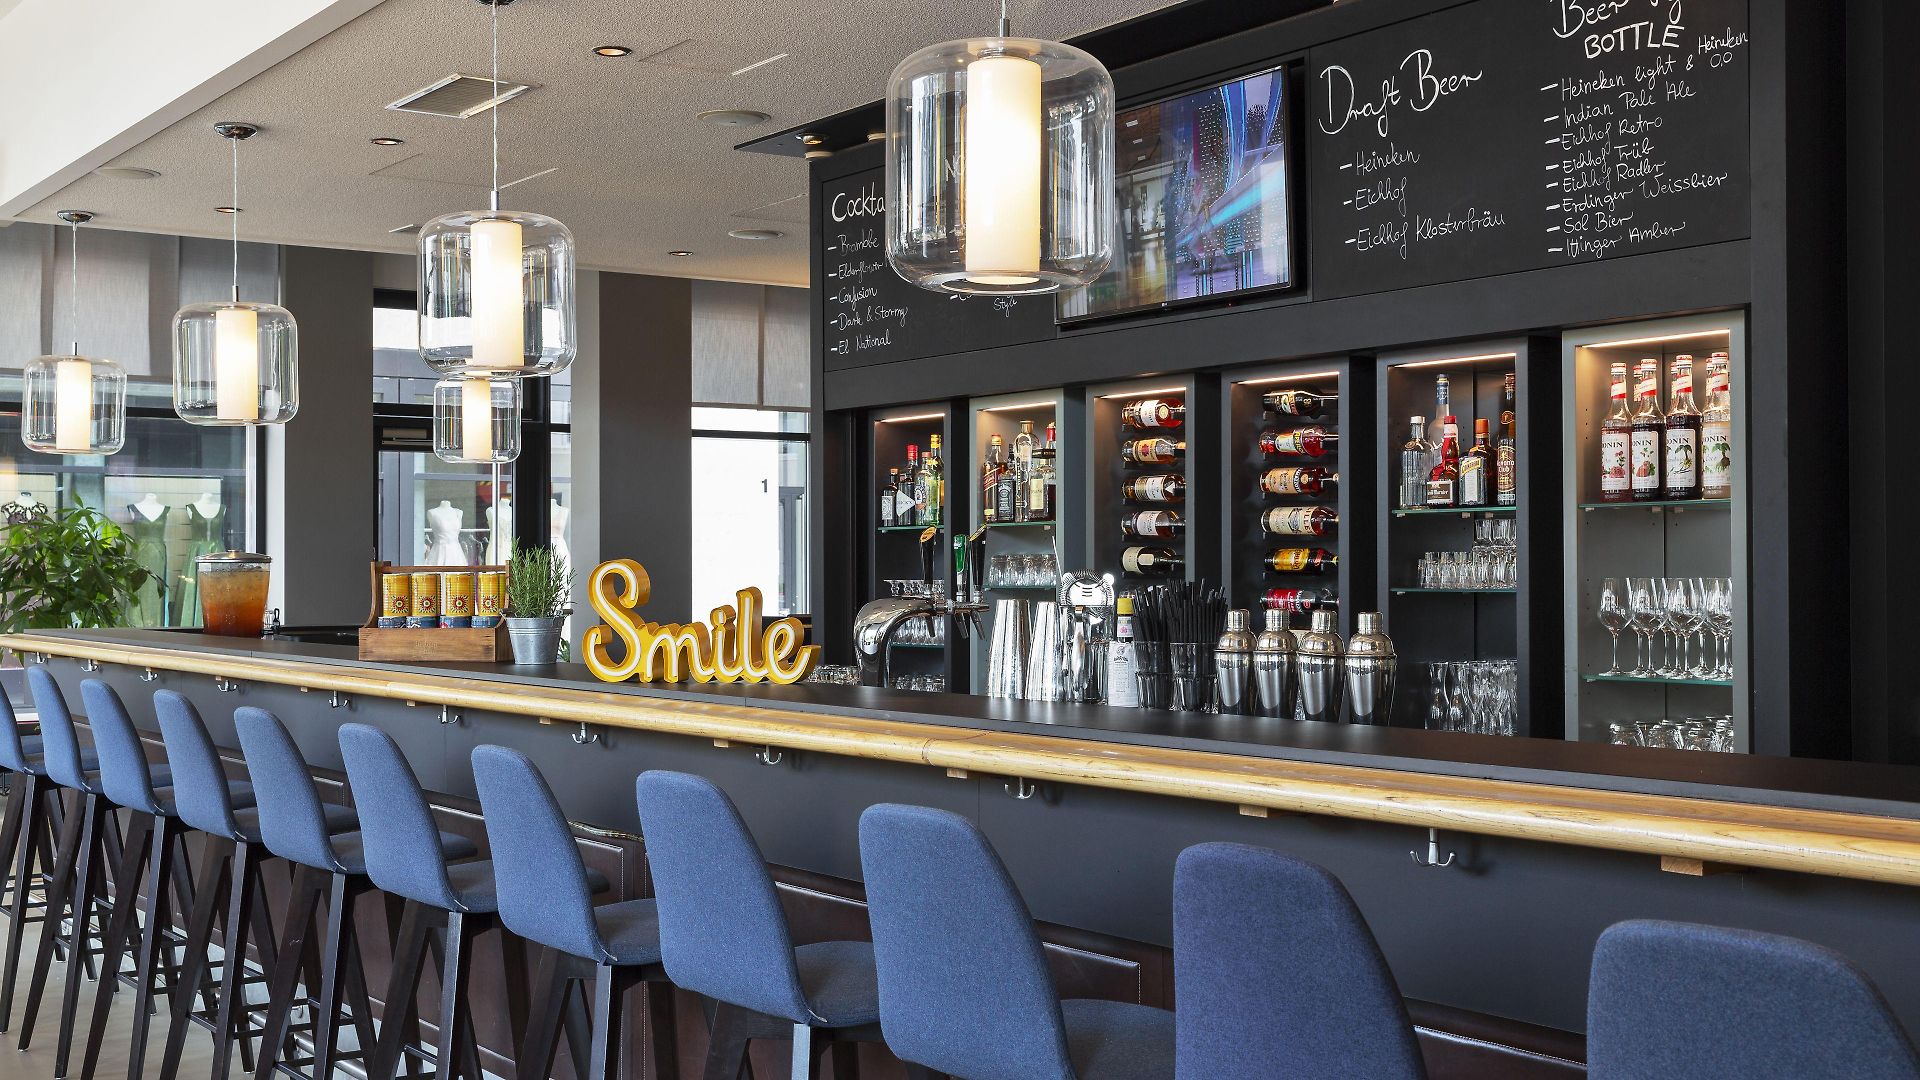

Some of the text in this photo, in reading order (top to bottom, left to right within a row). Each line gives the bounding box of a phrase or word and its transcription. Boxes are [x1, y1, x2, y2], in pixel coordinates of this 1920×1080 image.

[1553, 0, 1629, 38] Beer
[1584, 21, 1684, 59] BOTTLE
[1698, 27, 1748, 55] Heineken
[1319, 49, 1482, 137] Draft Beer
[1561, 70, 1625, 101] Heineken
[1635, 54, 1676, 89] light
[1686, 54, 1694, 71] &
[1564, 80, 1697, 128] Indian Pale Ale
[1561, 114, 1663, 155] Eichhof Retro
[1356, 142, 1421, 176] Heineken
[1562, 137, 1655, 174] Eichhof Trüb
[1562, 158, 1667, 193] Eichhof Radler
[1562, 172, 1728, 213] Erdinger Weissbier
[831, 182, 886, 222] Cockta
[1355, 177, 1407, 218] Eichhof
[1357, 207, 1506, 260] Eichhof Klosterbräu
[1563, 211, 1634, 234] Sol Bier
[1629, 221, 1686, 243] Amber
[838, 286, 878, 311] Confusion
[837, 312, 864, 331] Dark
[874, 305, 908, 328] Stormy
[838, 328, 891, 355] El National
[761, 479, 768, 493] 1
[582, 558, 821, 685] Smile
